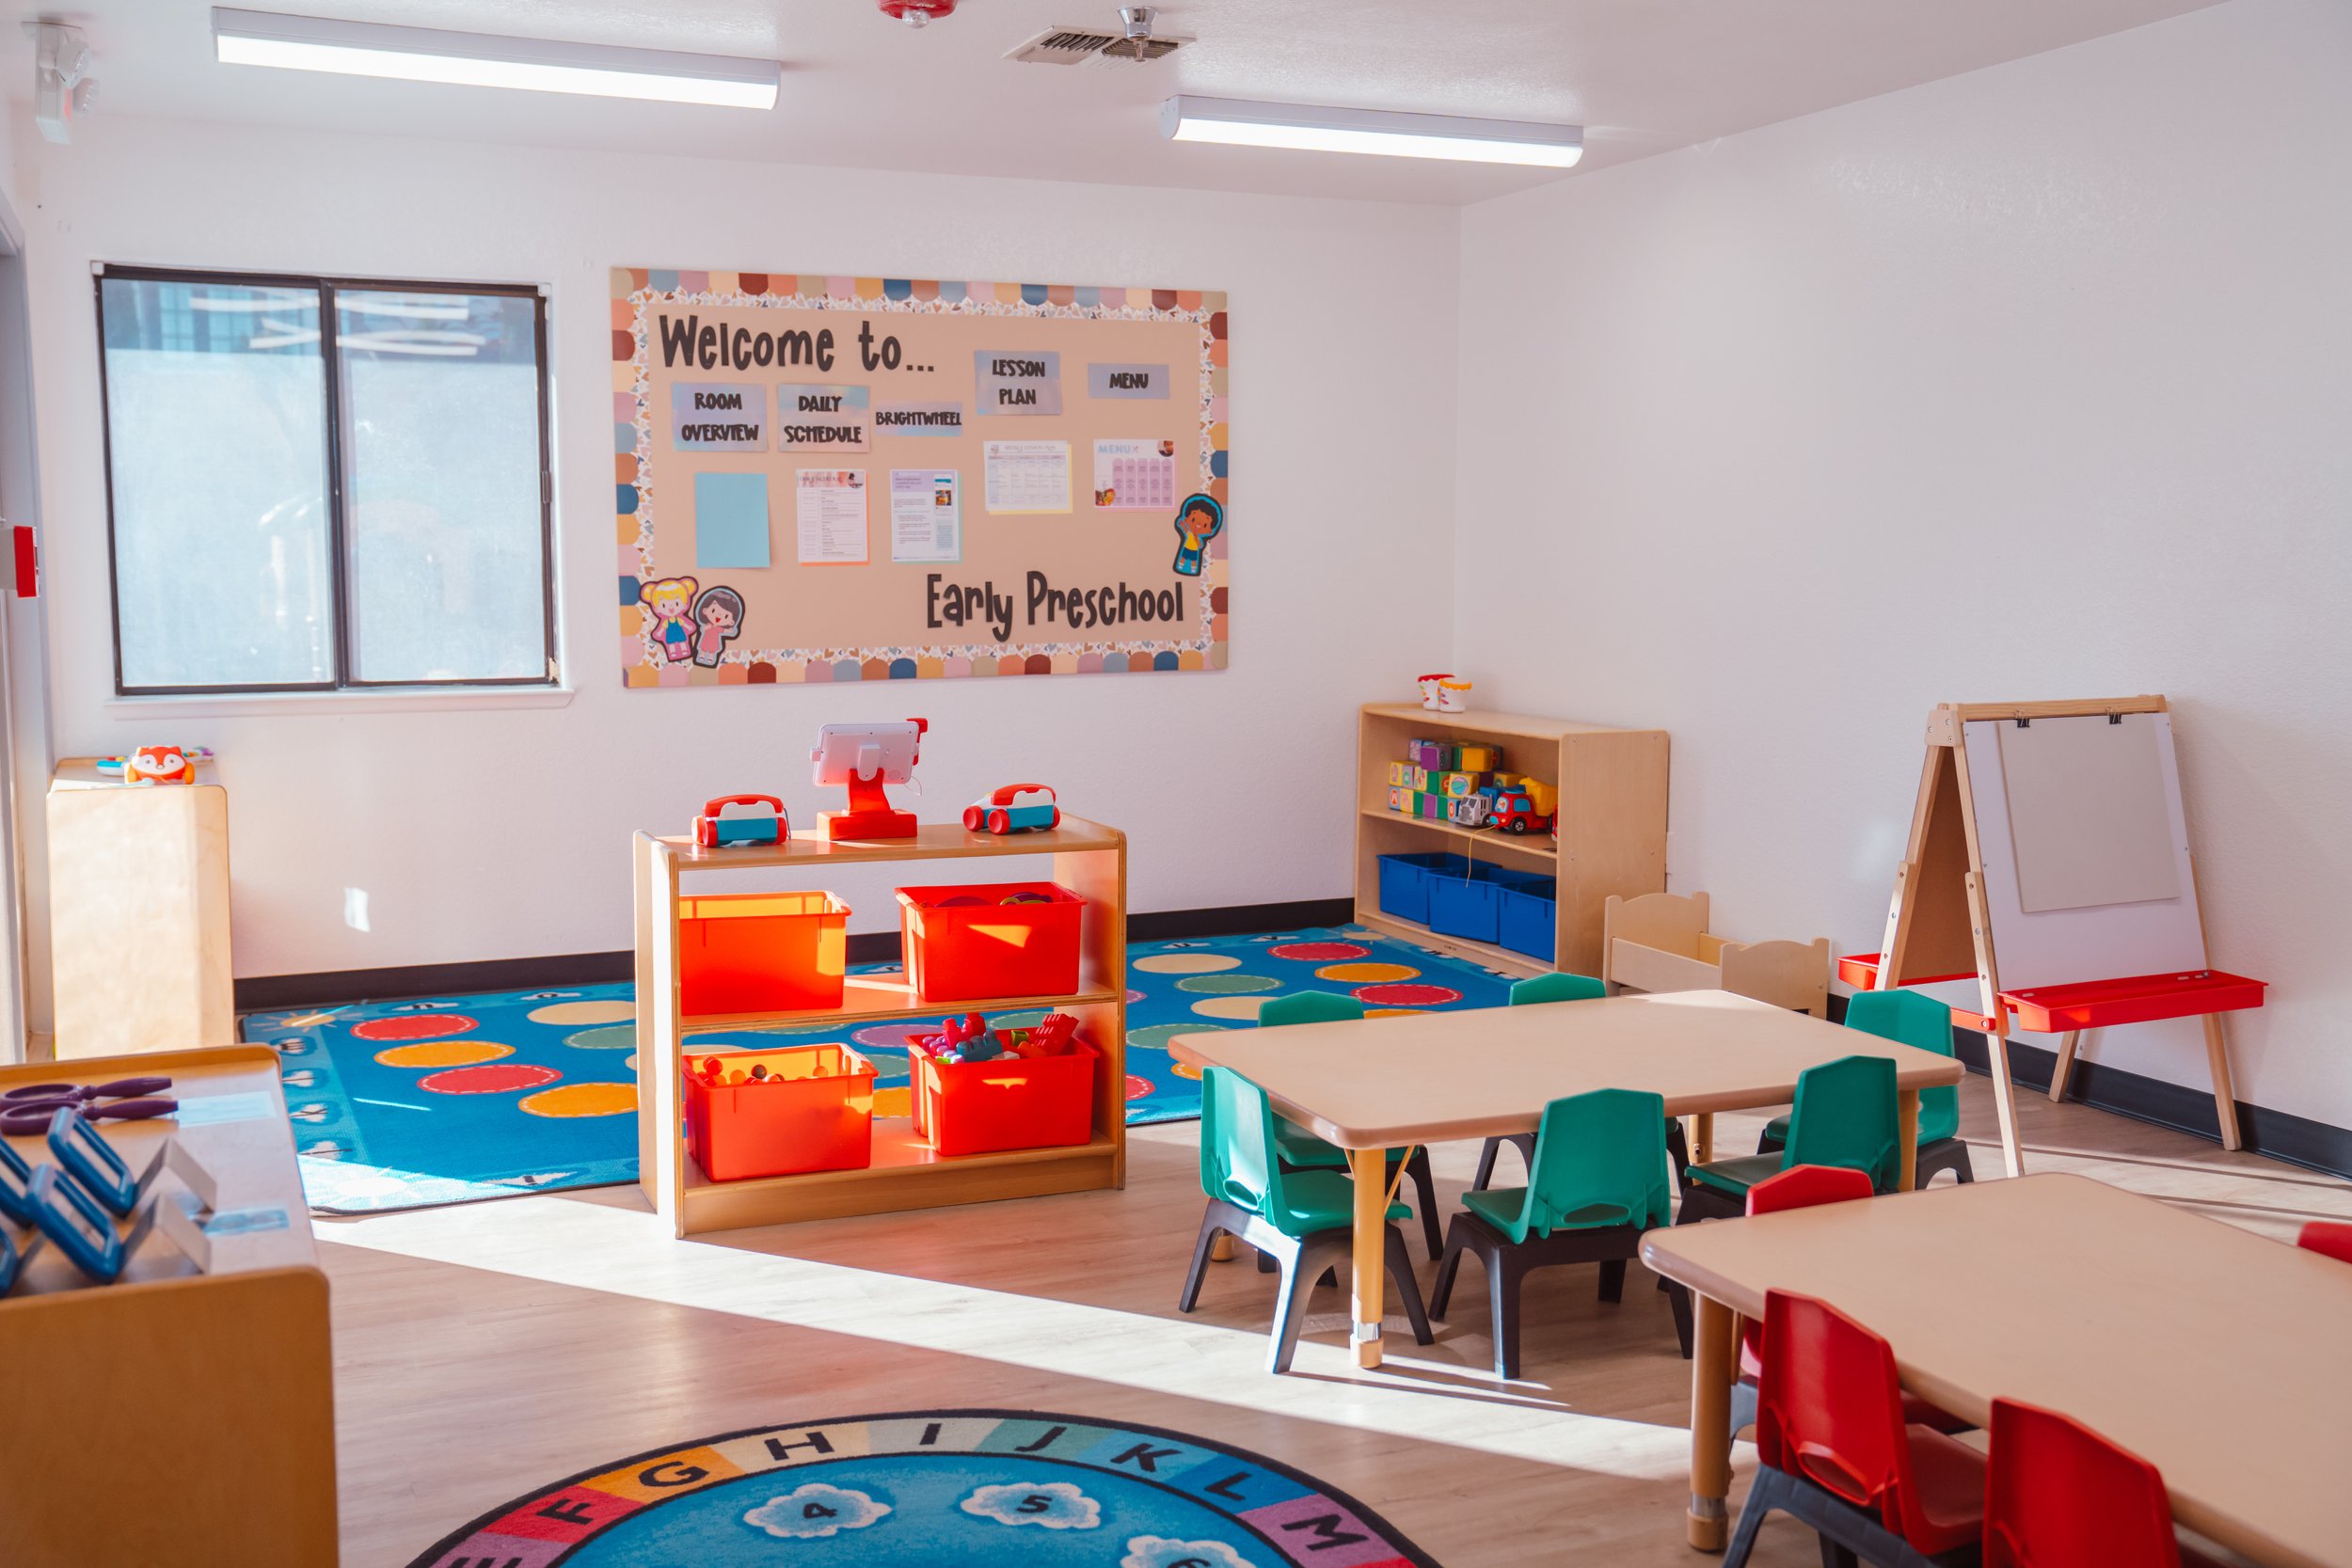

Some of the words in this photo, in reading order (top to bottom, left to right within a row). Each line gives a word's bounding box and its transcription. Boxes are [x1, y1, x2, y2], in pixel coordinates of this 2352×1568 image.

[659, 314, 834, 372] Welcome
[858, 320, 934, 372] to...
[993, 359, 1045, 377] LESSON
[1109, 372, 1149, 389] MENU
[694, 392, 742, 410] ROOM
[798, 395, 842, 412] DAILY
[999, 388, 1037, 405] PLAN
[875, 411, 961, 426] BRIGHTWHEEL
[681, 423, 759, 442] OVERVIEW
[784, 425, 862, 444] SCHEDULE
[1098, 444, 1131, 453] MENU
[927, 573, 1013, 642] Early
[1026, 570, 1184, 629] Preschool
[536, 1498, 594, 1525] F
[638, 1461, 709, 1487] G
[764, 1431, 834, 1461] H
[919, 1422, 943, 1446] I
[1014, 1426, 1067, 1452] J
[1110, 1443, 1183, 1472] K
[1204, 1471, 1252, 1501] L
[1280, 1513, 1370, 1551] M
[803, 1502, 837, 1519] 4
[1016, 1495, 1053, 1513] 5
